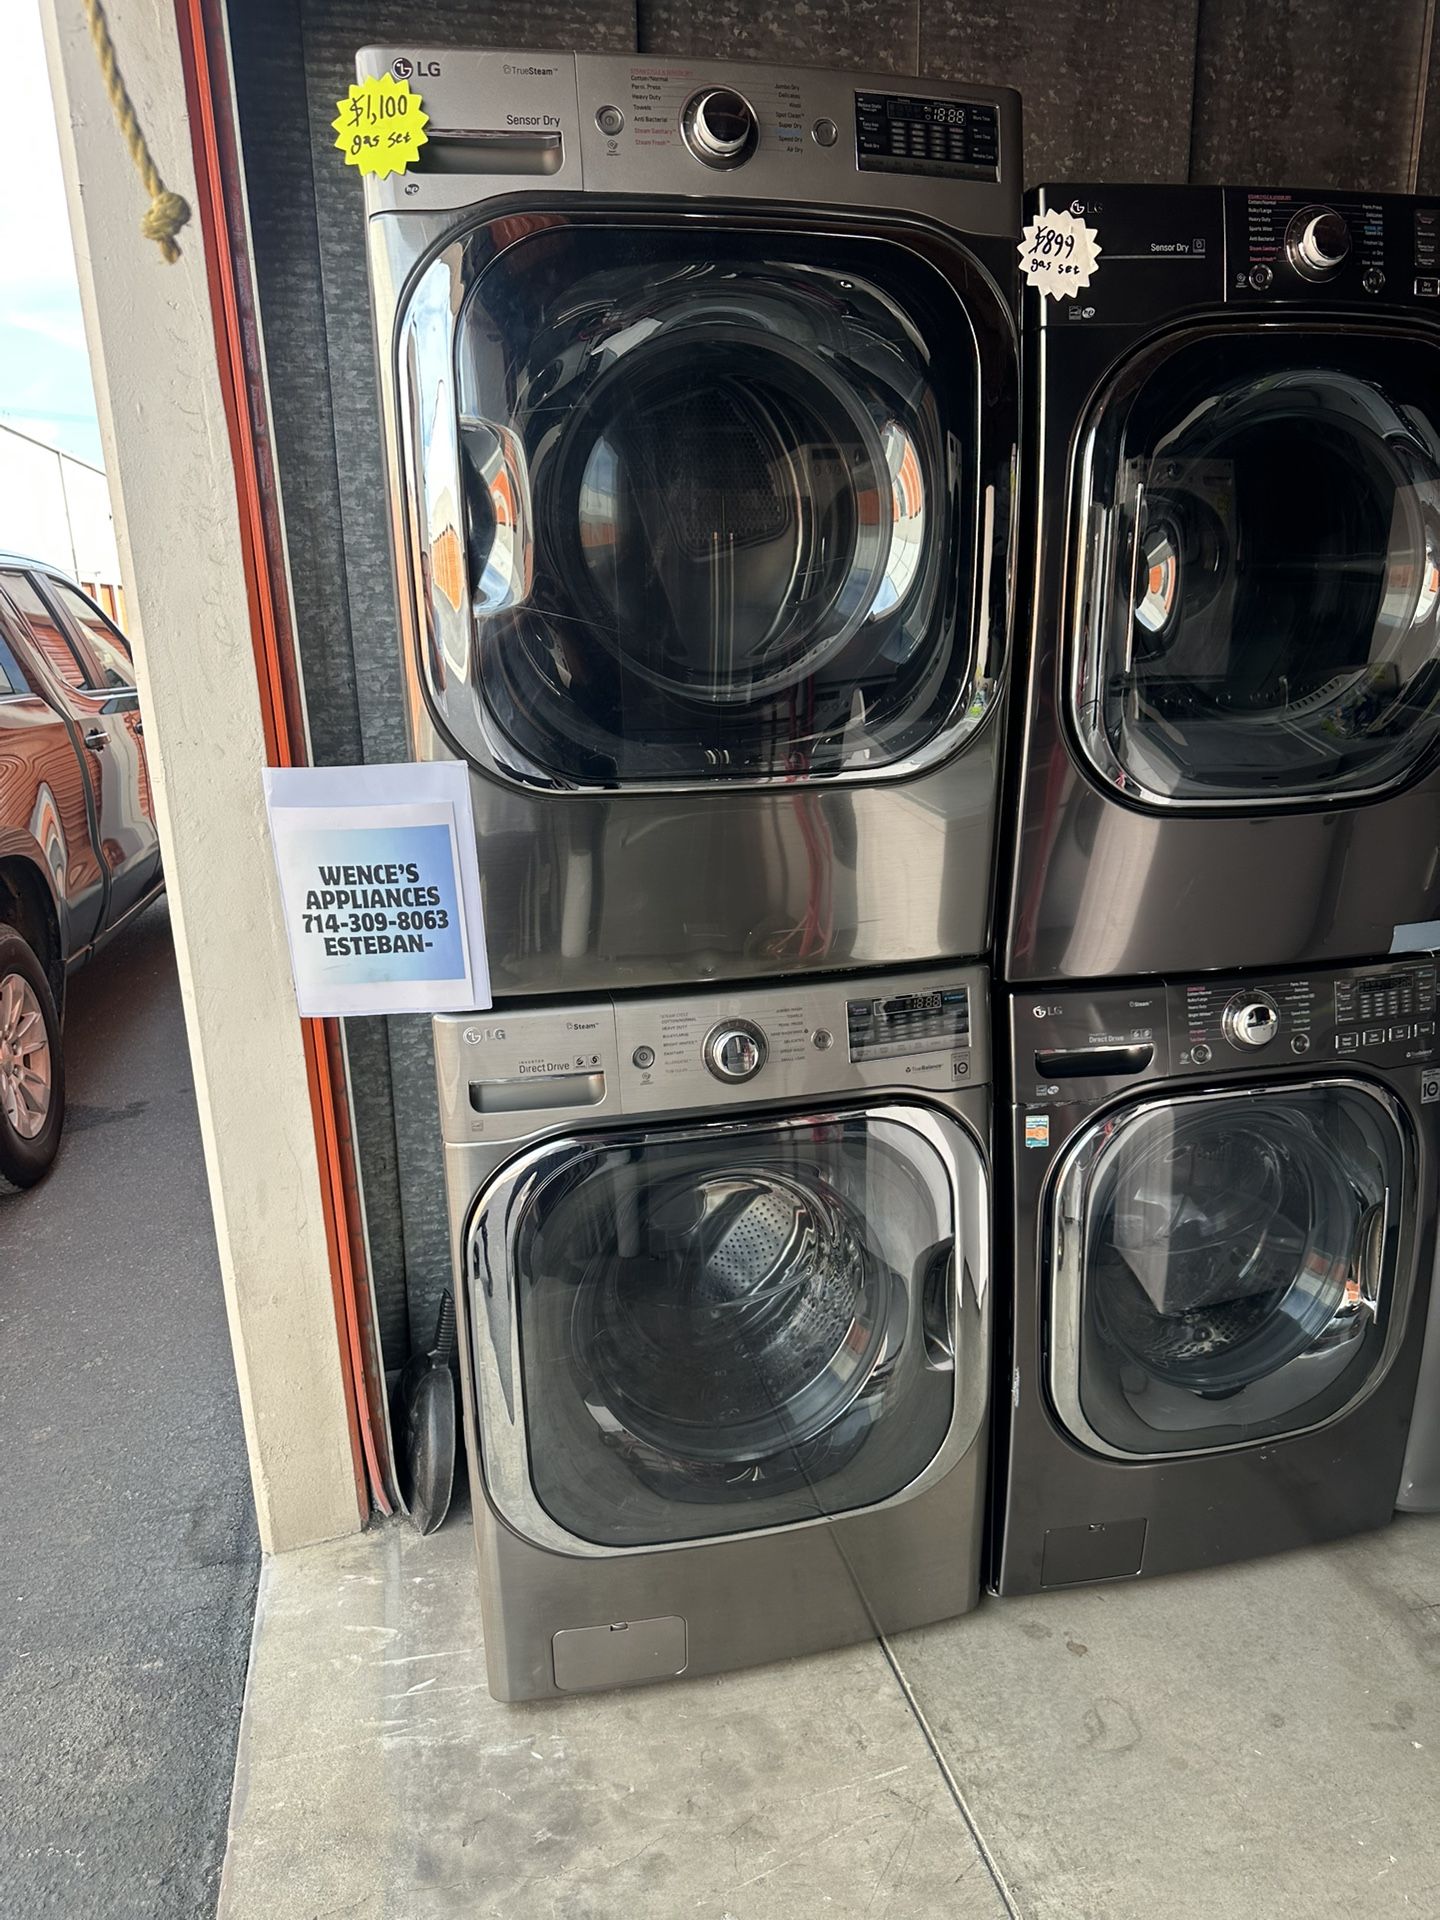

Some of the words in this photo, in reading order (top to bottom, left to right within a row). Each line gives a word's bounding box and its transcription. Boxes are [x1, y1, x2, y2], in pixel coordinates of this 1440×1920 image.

[417, 61, 441, 77] LG
[347, 94, 408, 127] $1,100
[506, 115, 541, 126] Sensor
[543, 115, 561, 127] Dry
[350, 133, 380, 155] gas
[387, 131, 412, 149] set
[1028, 225, 1076, 260] $899
[1150, 243, 1176, 252] Sensor
[1176, 243, 1190, 254] Dry
[1030, 257, 1052, 273] gas
[1057, 262, 1081, 275] set
[318, 863, 420, 886] WENCE'S
[306, 886, 441, 909] APPLIANCES
[302, 909, 449, 933] 714-309-8063
[323, 934, 433, 956] ESTEBAN-
[1047, 1006, 1063, 1016] LG
[484, 1029, 506, 1041] LG
[1089, 1036, 1108, 1044] Direct
[519, 1063, 546, 1073] Direct
[547, 1062, 570, 1071] Drive
